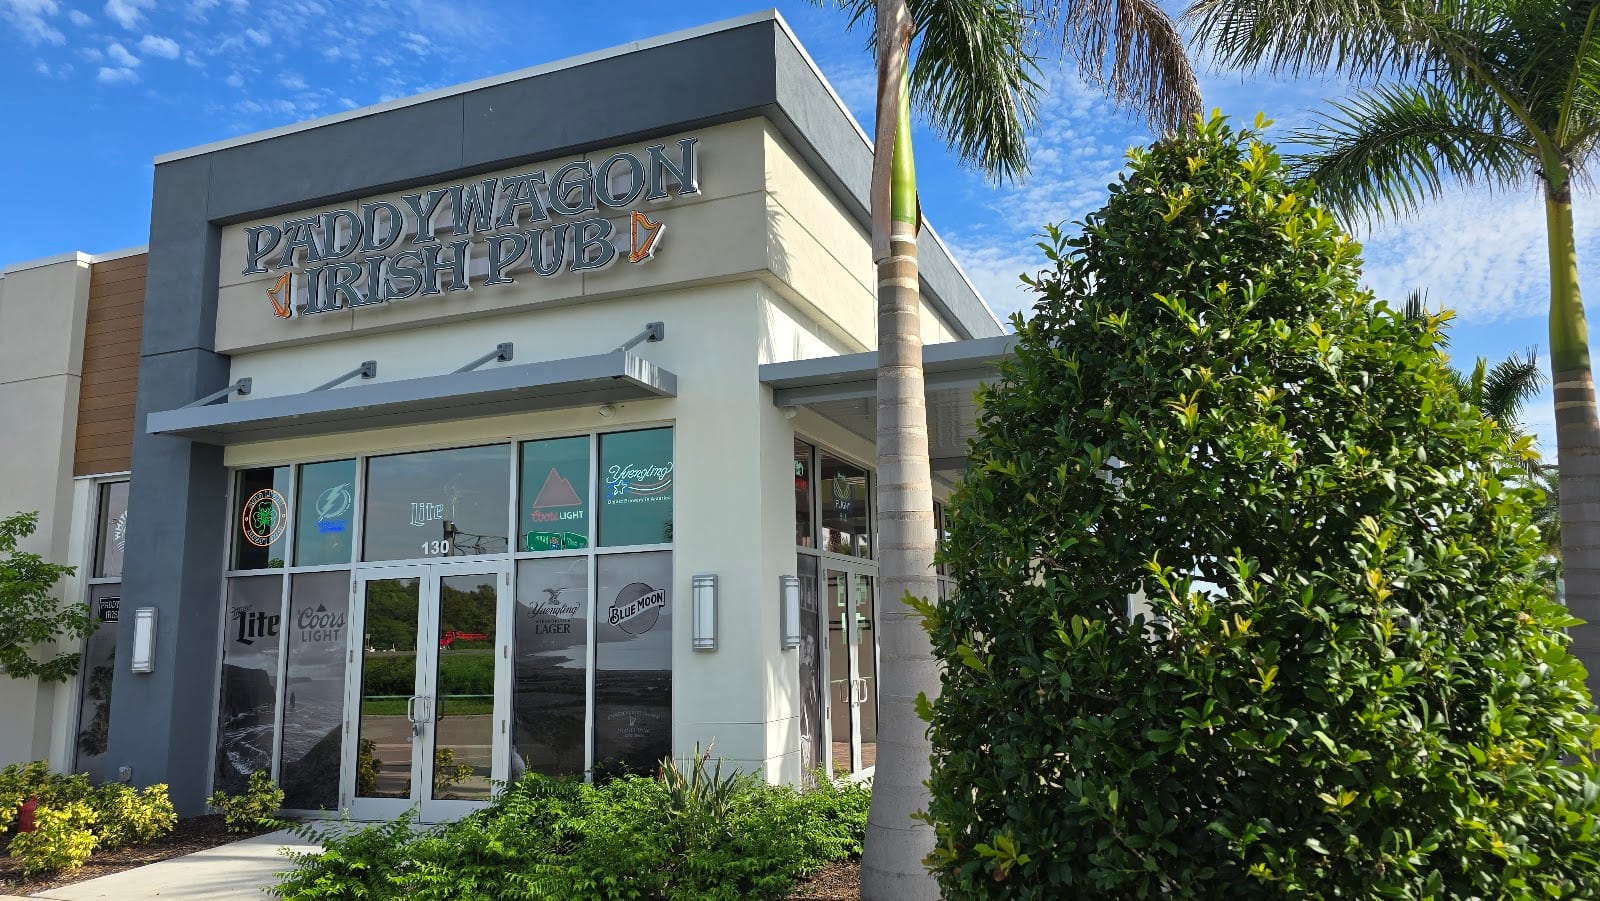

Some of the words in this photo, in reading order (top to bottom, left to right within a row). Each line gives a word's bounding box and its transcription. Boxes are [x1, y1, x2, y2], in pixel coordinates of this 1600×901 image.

[241, 137, 699, 276] PADDYWAGON
[302, 239, 470, 316] IRISH
[483, 217, 617, 287] PUB
[606, 461, 673, 484] Yuengling
[410, 502, 444, 527] Lite
[559, 510, 584, 520] LIGHT
[422, 540, 449, 555] 130
[298, 607, 345, 629] Coors
[528, 601, 580, 618] Yuengling
[609, 603, 636, 625] BLUE
[637, 592, 663, 610] MOON
[236, 611, 280, 645] Lite
[301, 629, 339, 642] LIGHT
[535, 623, 571, 635] LAGER
